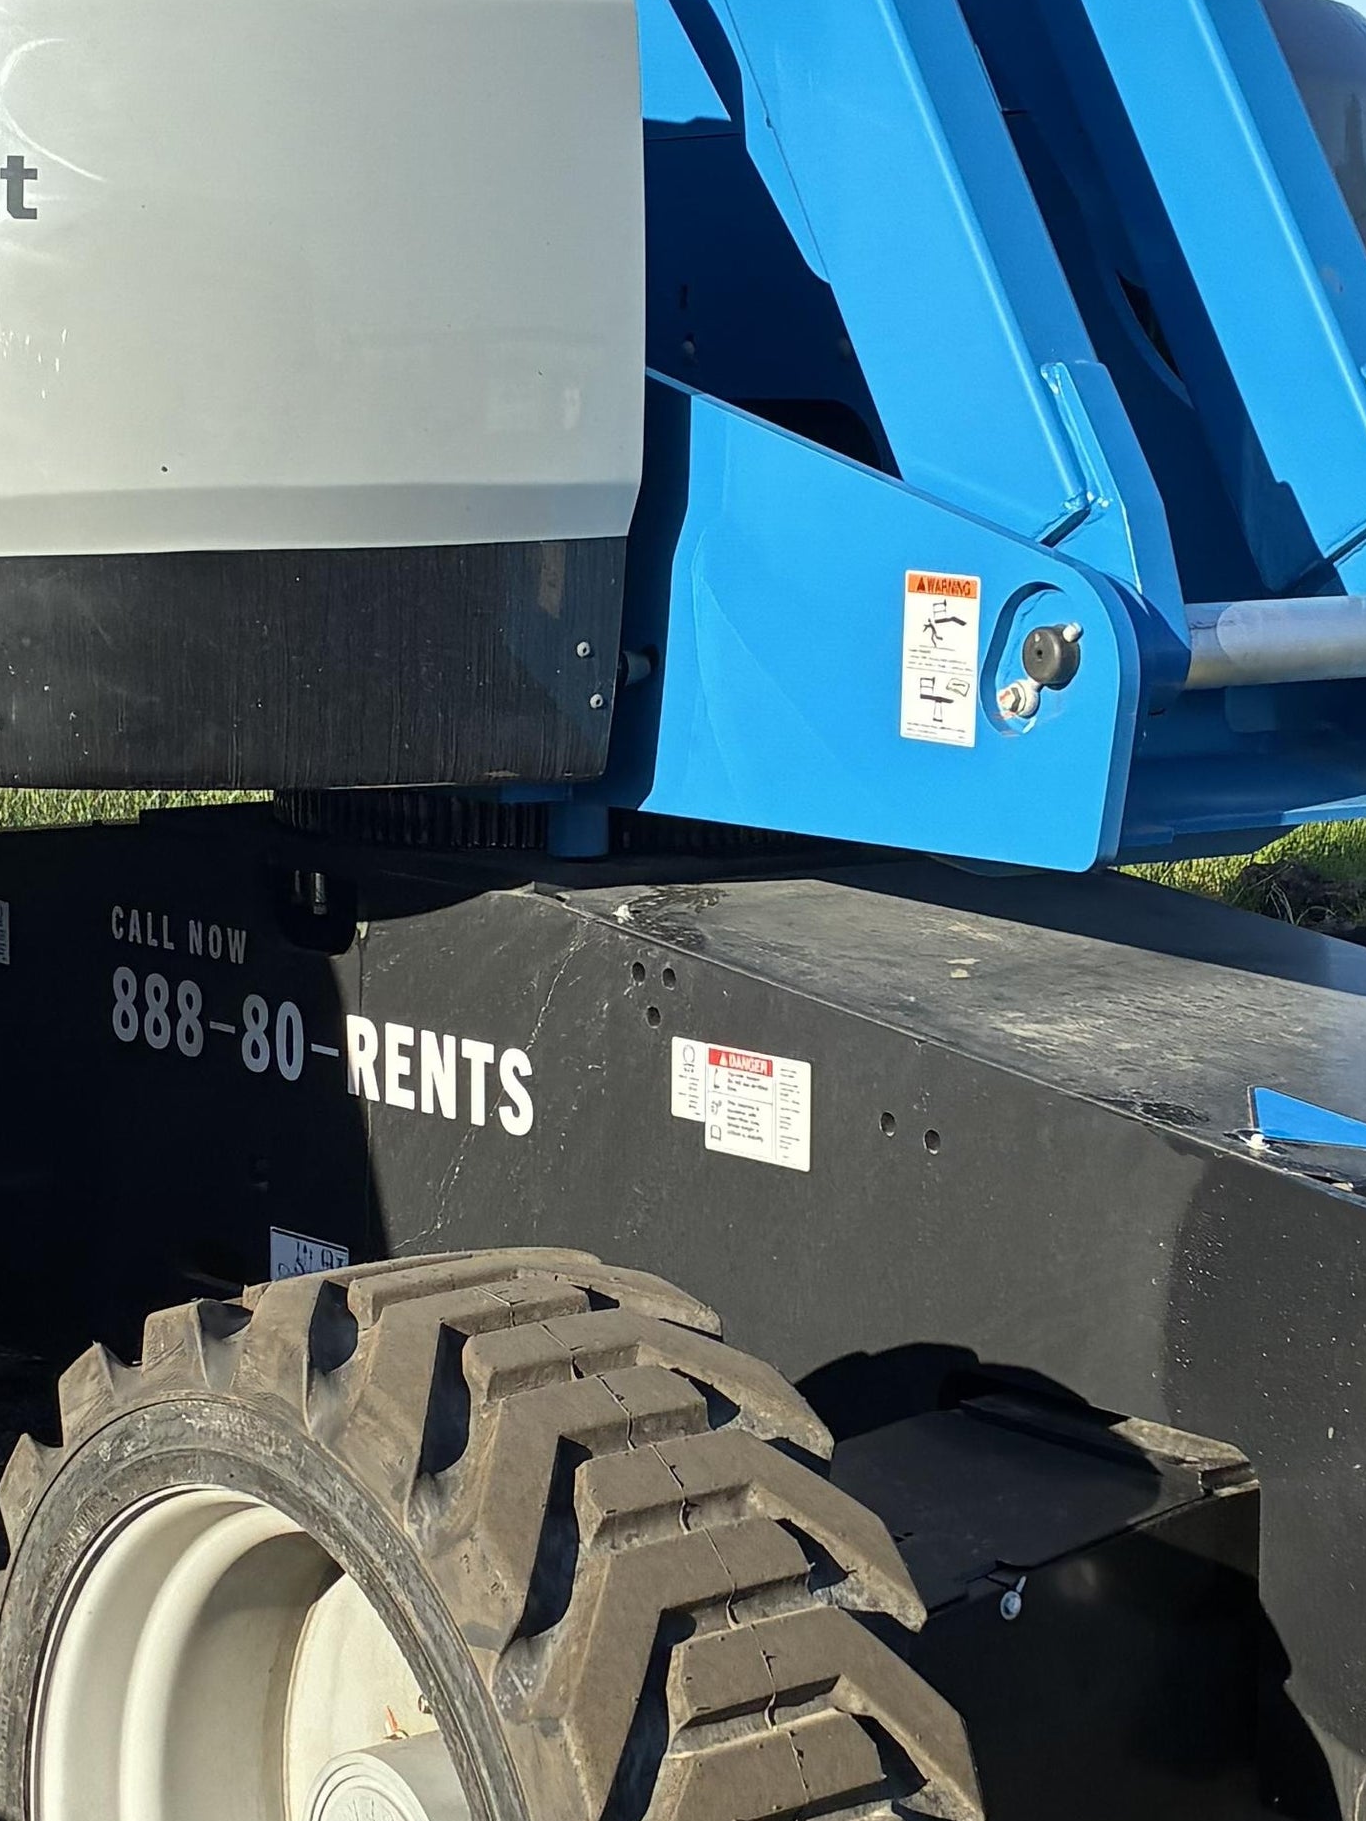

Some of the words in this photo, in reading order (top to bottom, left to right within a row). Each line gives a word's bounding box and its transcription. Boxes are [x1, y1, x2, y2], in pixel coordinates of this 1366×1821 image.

[926, 576, 972, 596] WARNING
[111, 905, 175, 951] CALL
[188, 919, 248, 965] NOW
[112, 966, 534, 1137] 888-80-RENTS
[729, 1053, 769, 1076] DANGER
